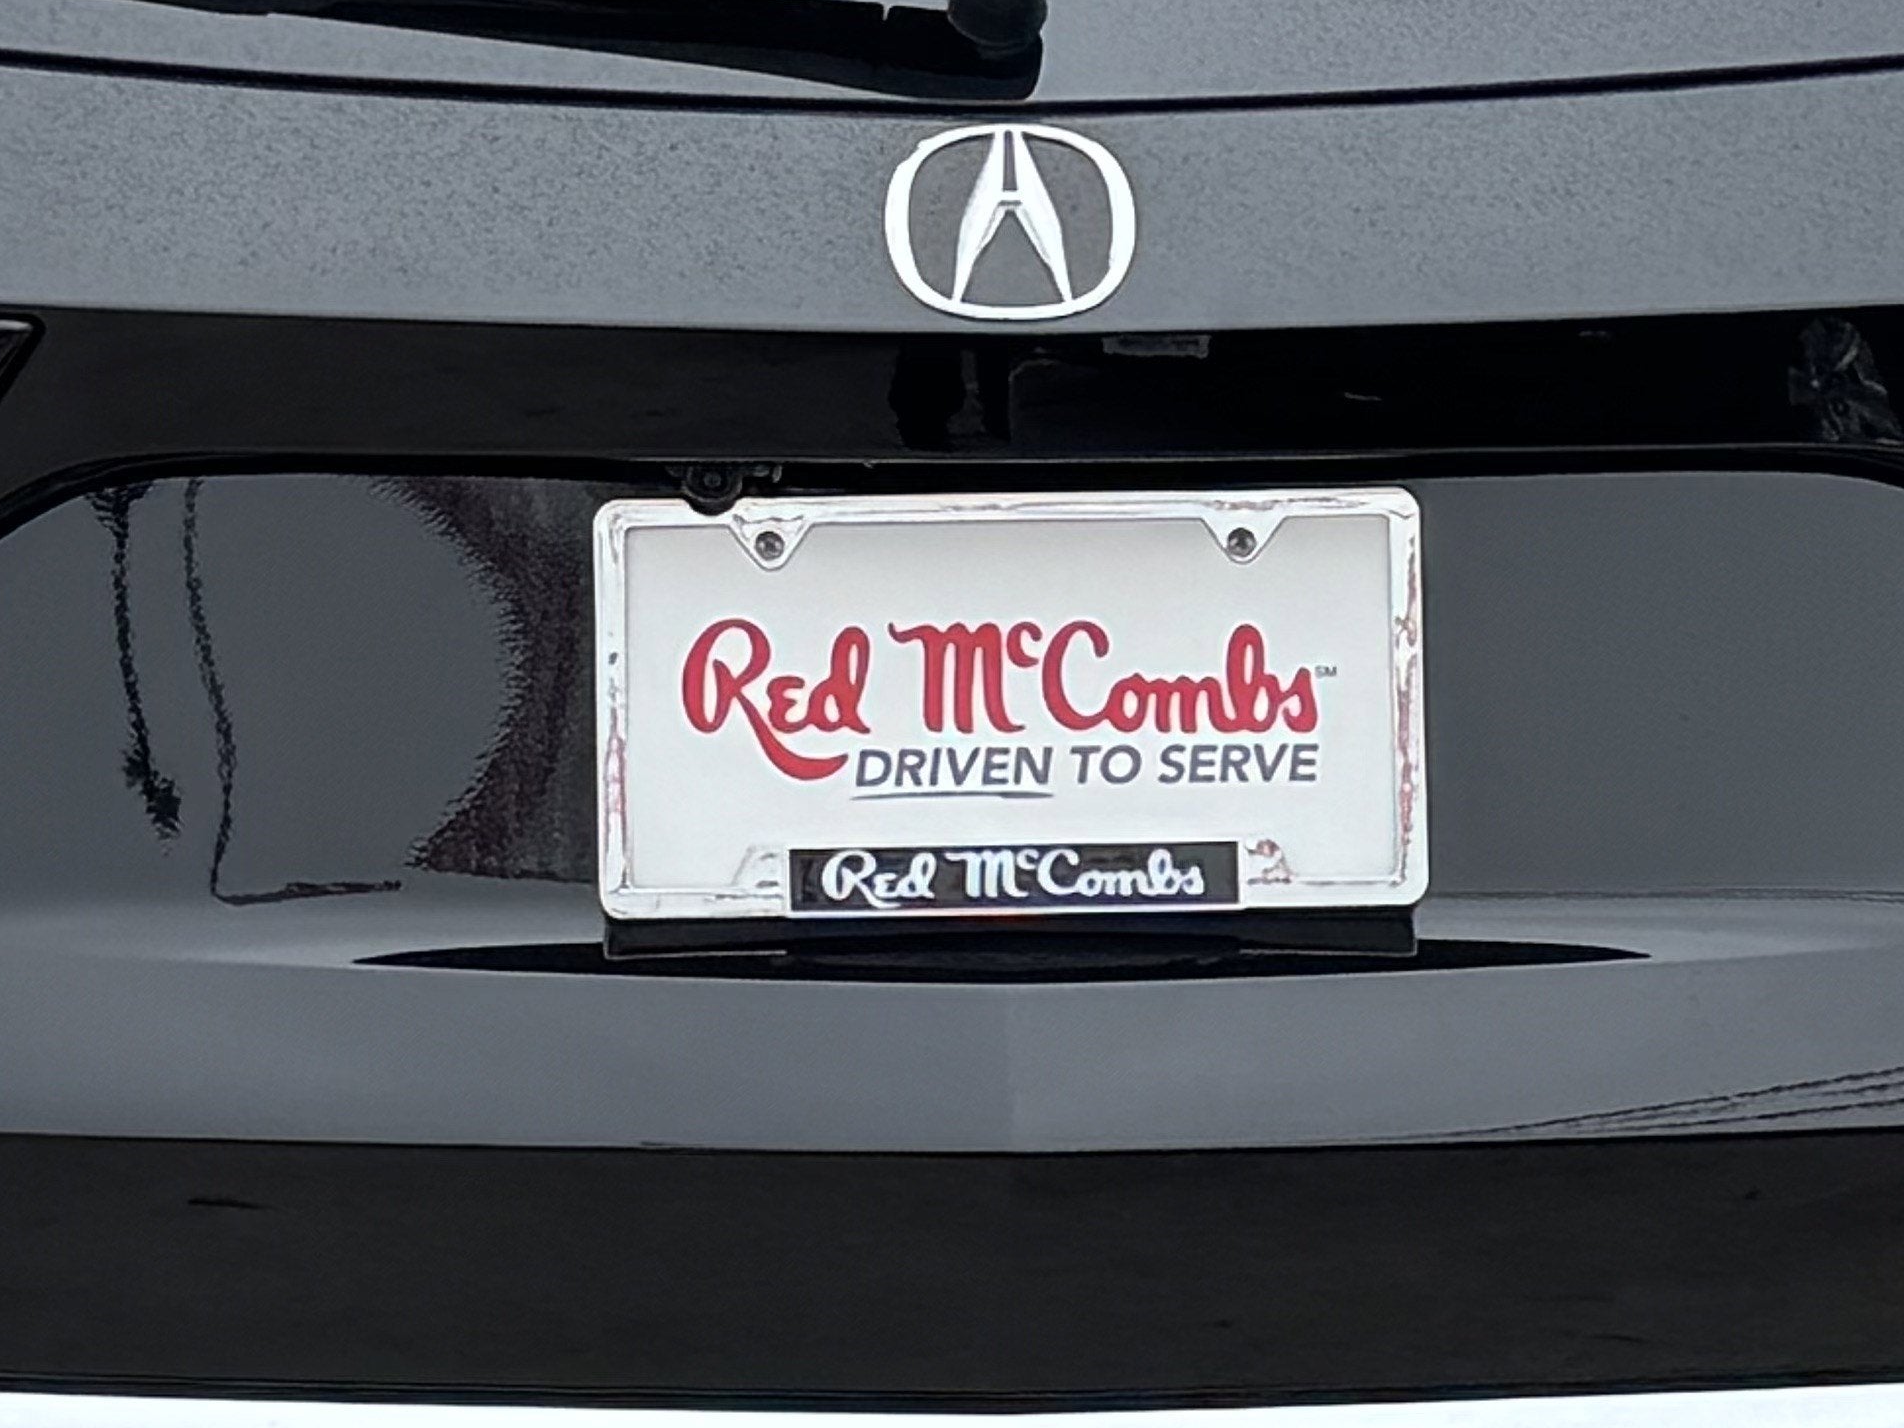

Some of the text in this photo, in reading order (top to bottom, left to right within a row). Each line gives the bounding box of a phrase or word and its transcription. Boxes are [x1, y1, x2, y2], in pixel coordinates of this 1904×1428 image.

[681, 617, 871, 781] Red
[887, 618, 1318, 734] McCombs
[855, 742, 1319, 788] DRIVEN TO SERVE
[821, 847, 1205, 909] Red McCombs
